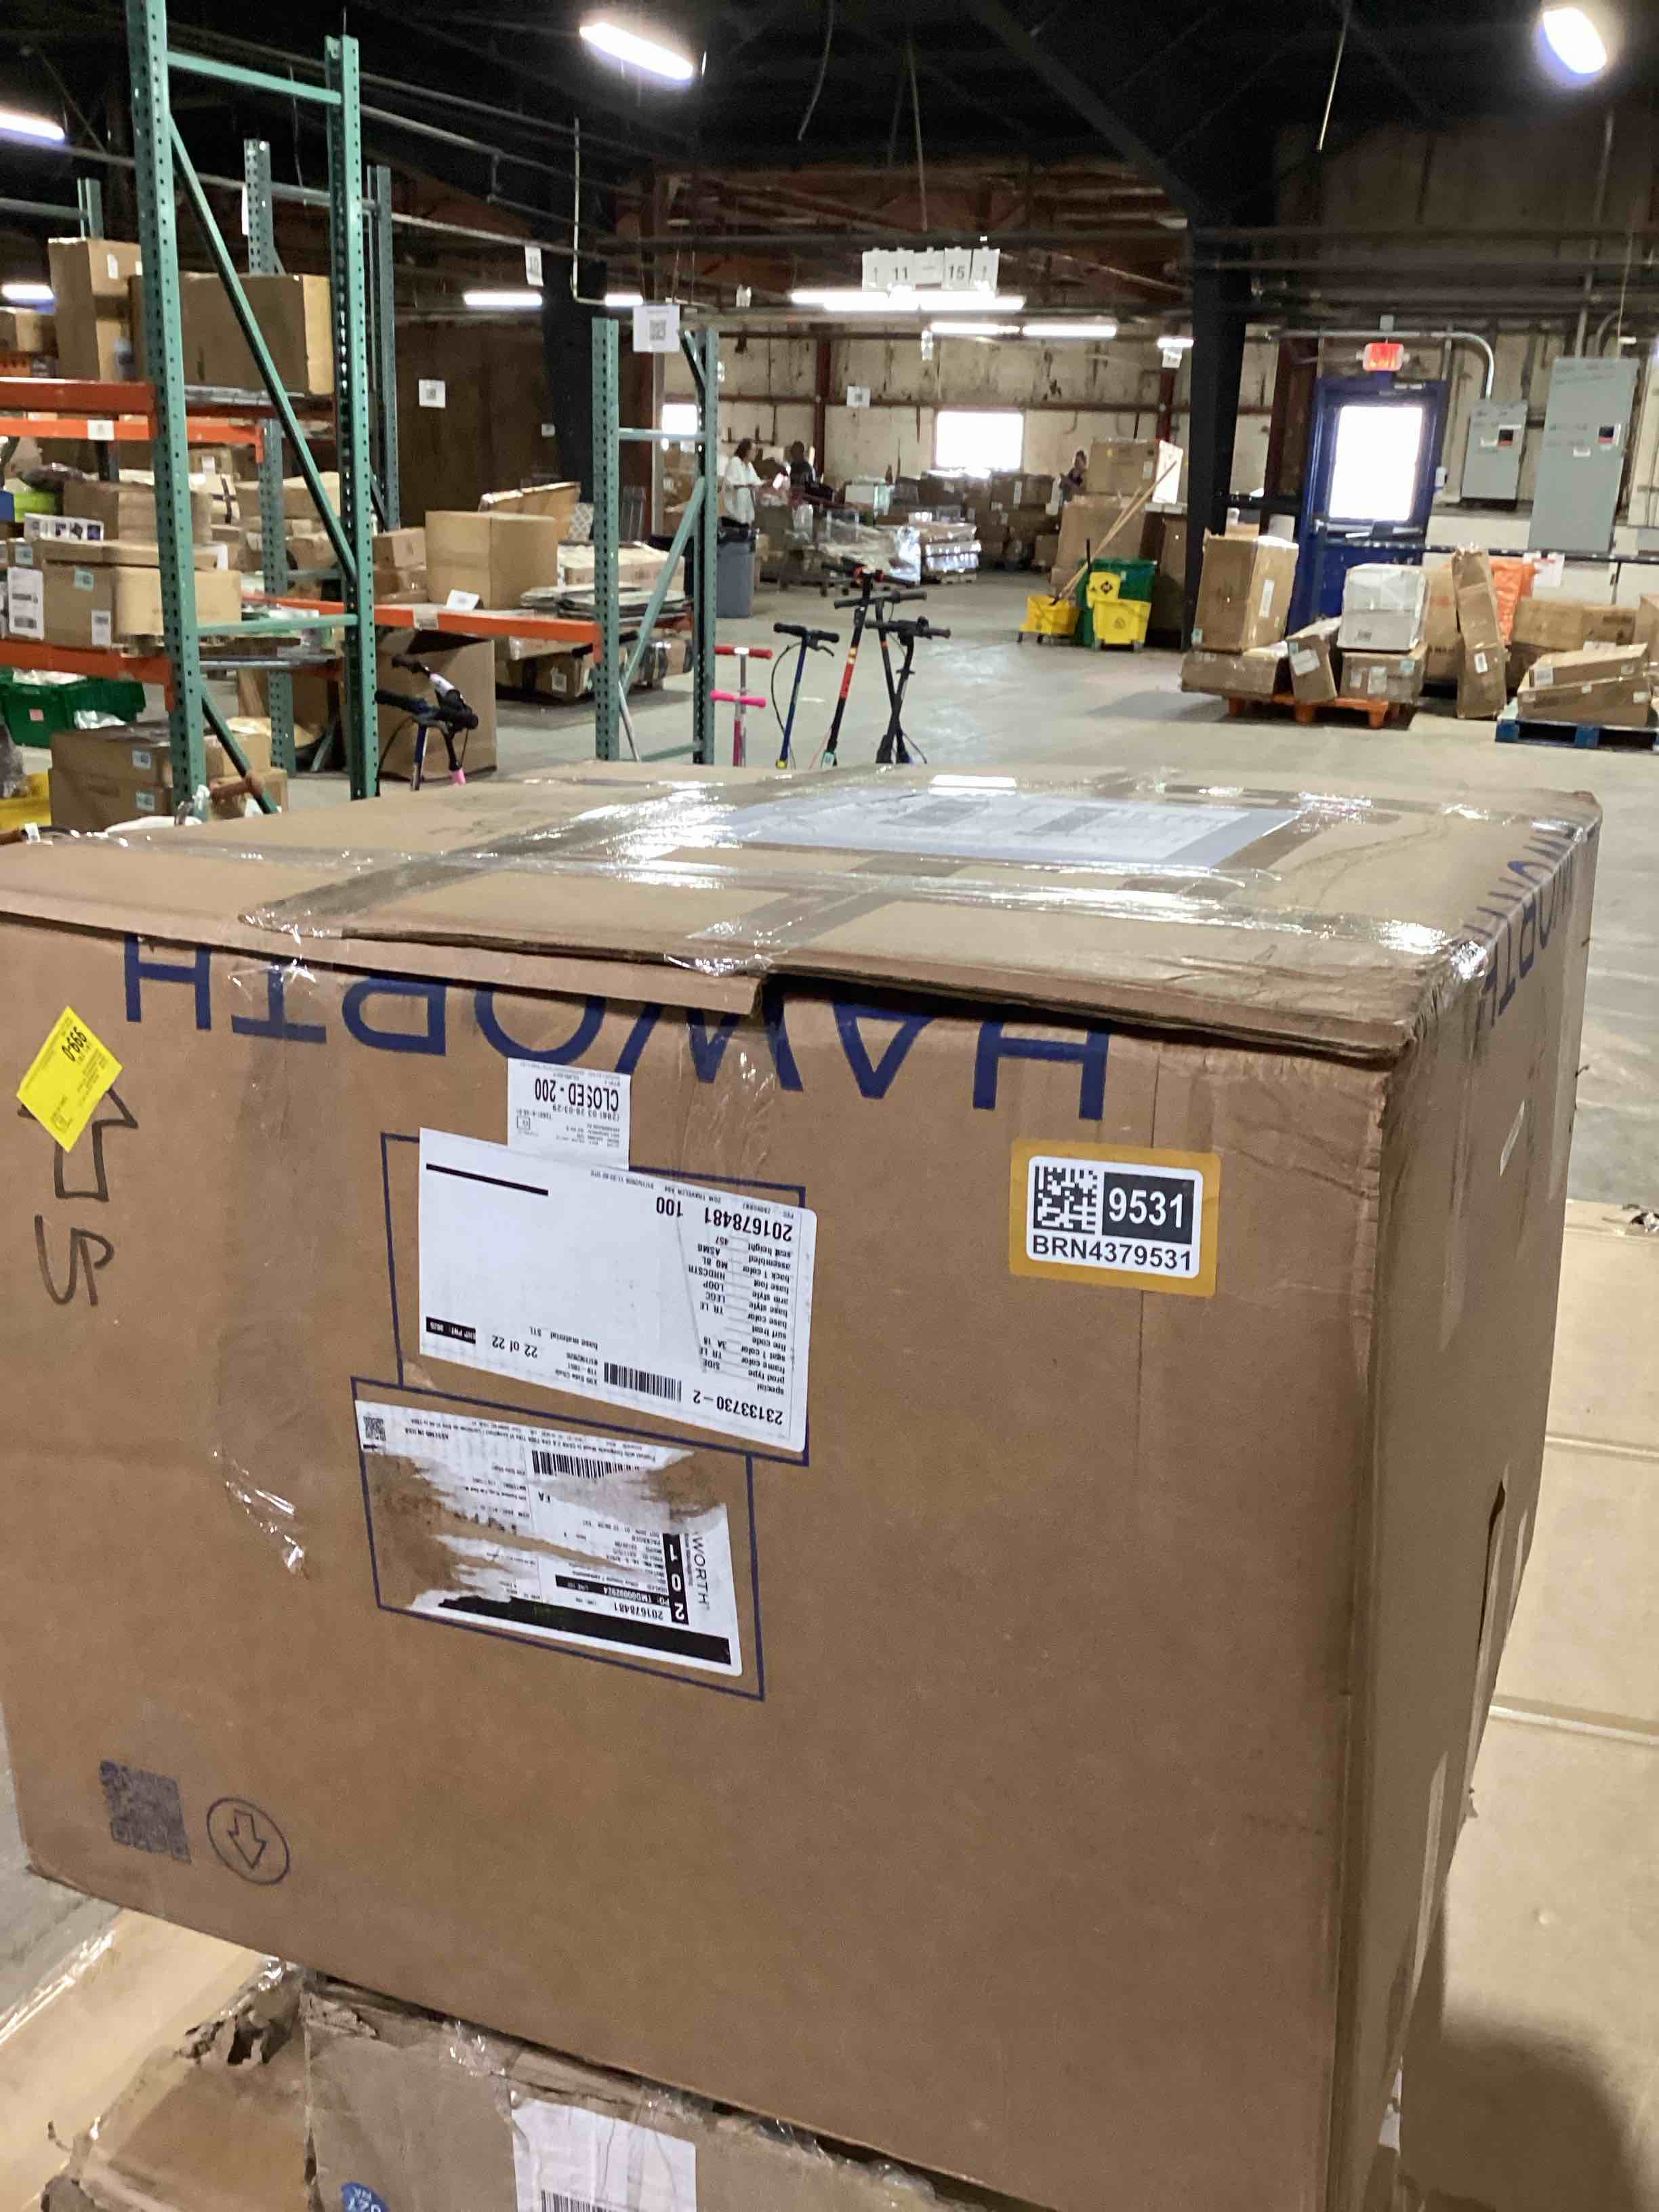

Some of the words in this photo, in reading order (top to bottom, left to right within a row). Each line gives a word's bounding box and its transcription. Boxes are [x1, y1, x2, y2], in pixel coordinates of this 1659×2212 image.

[535, 1078, 555, 1103] 200
[569, 1082, 618, 1112] CLOSED
[655, 1195, 683, 1218] 100
[1109, 1187, 1184, 1229] 9531
[704, 1206, 792, 1242] 201678481
[747, 1242, 771, 1255] height
[1033, 1235, 1191, 1271] BRN4379531
[34, 1214, 115, 1307] UP
[742, 1265, 761, 1277] color
[771, 1283, 788, 1294] base
[752, 1290, 769, 1302] style
[748, 1300, 766, 1313] style
[769, 1306, 787, 1317] base
[747, 1312, 766, 1324] color
[769, 1317, 787, 1329] base
[491, 1334, 504, 1350] 22
[510, 1340, 519, 1354] of
[752, 1336, 770, 1348] code
[524, 1343, 537, 1359] 22
[740, 1345, 760, 1357] color
[741, 1356, 760, 1368] color
[747, 1368, 764, 1380] type
[766, 1373, 784, 1385] prod
[756, 1381, 784, 1397] special
[693, 1389, 700, 1405] 2
[716, 1395, 783, 1426] 23133730
